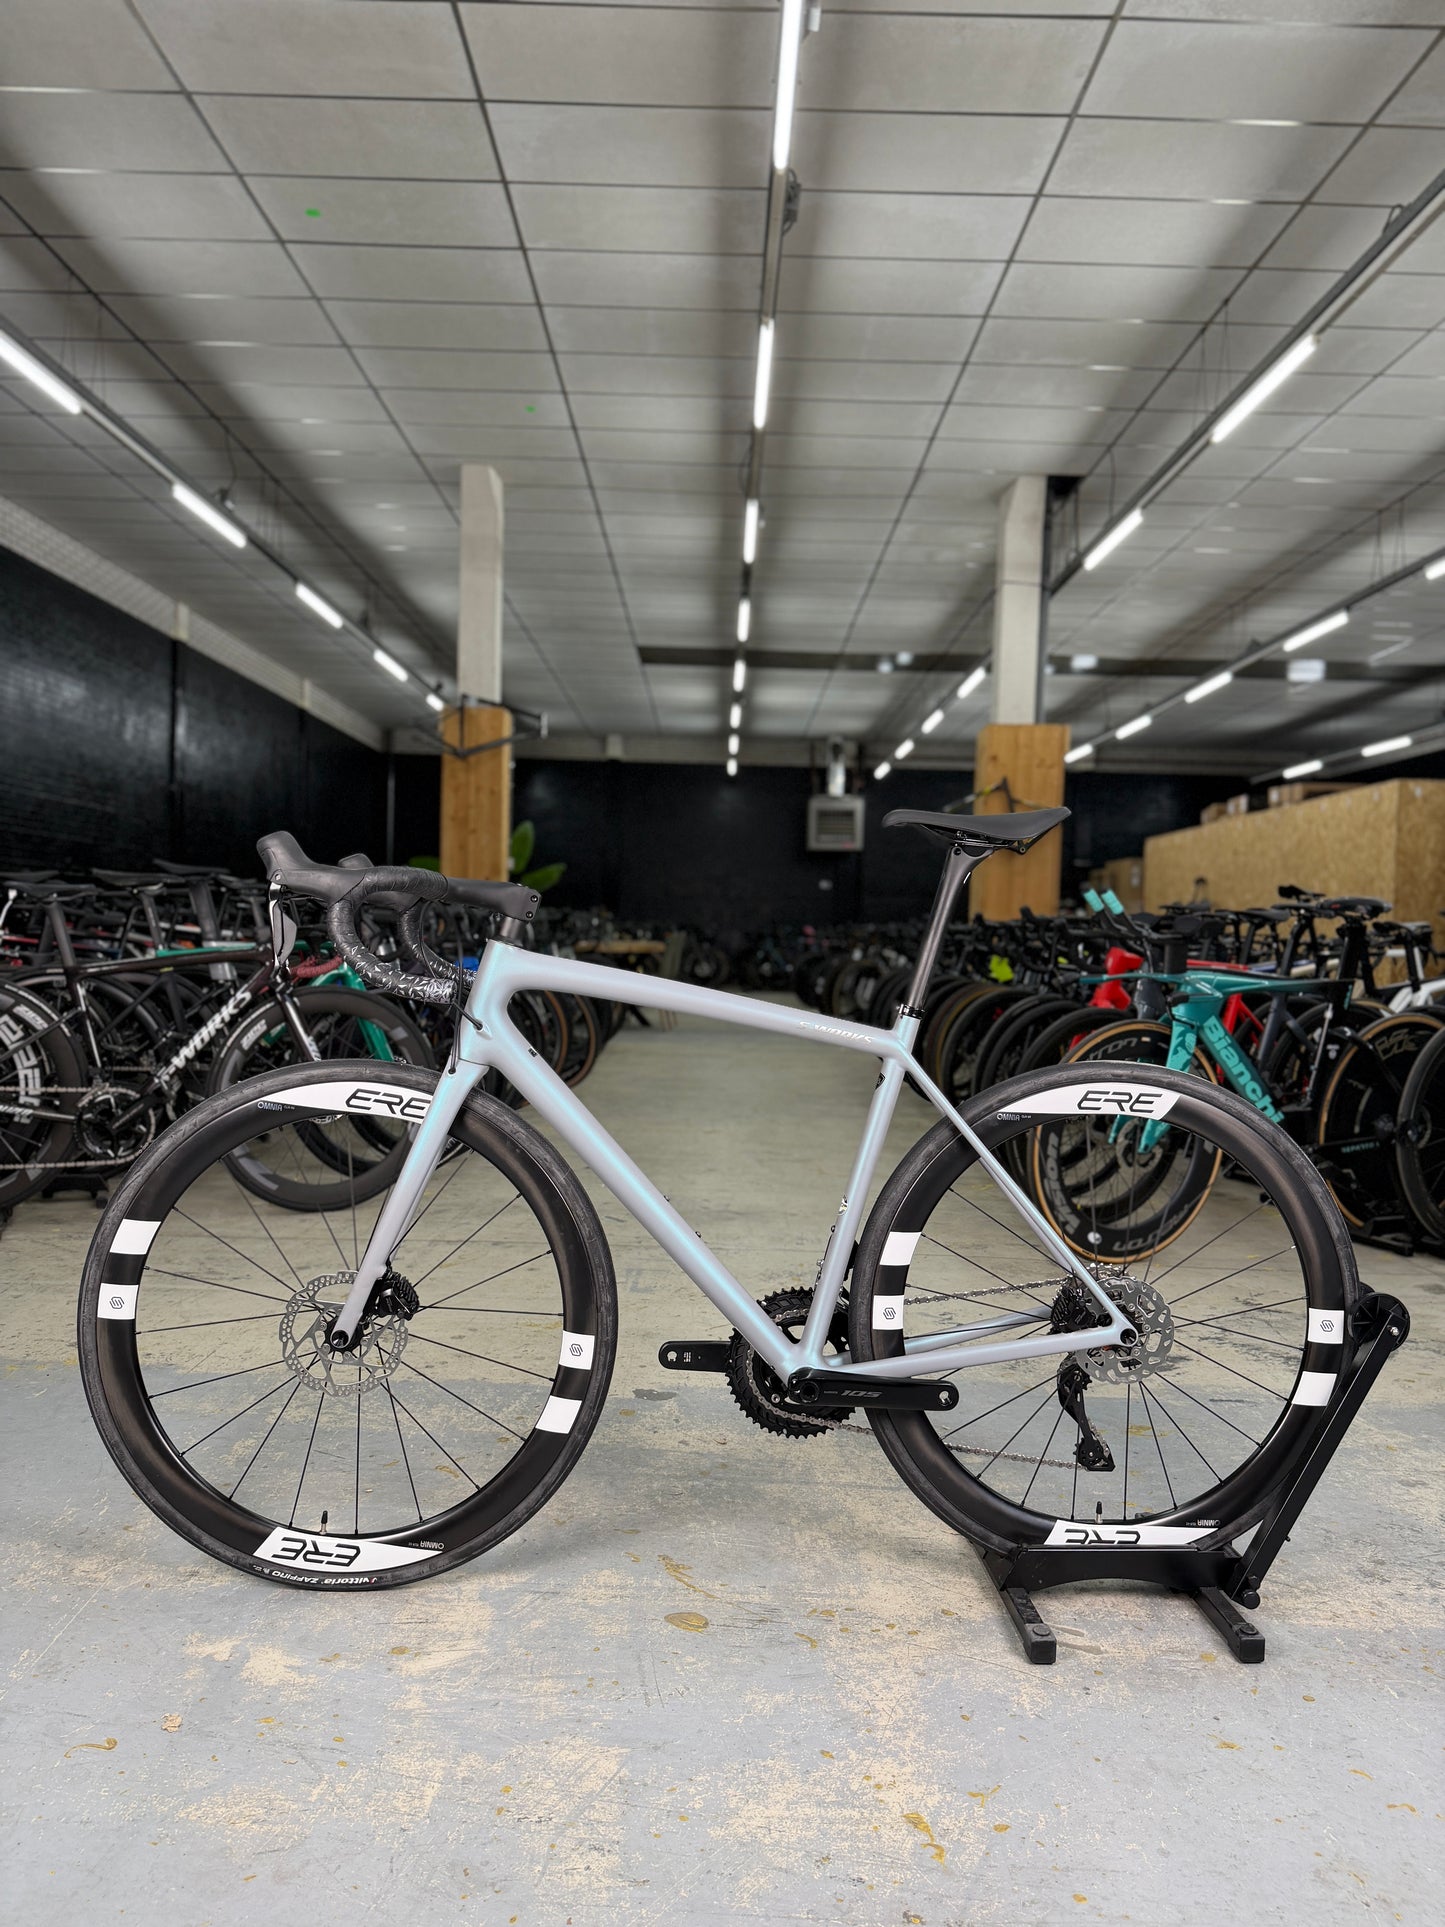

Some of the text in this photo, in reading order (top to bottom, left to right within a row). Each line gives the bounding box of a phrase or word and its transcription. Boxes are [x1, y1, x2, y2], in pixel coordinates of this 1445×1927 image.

[1203, 1015, 1285, 1123] Bianchi
[257, 1101, 283, 1112] OMNIA
[345, 1087, 431, 1119] ERE
[1077, 1089, 1163, 1113] ERE
[996, 1113, 1021, 1122] OMNIA
[840, 1389, 883, 1398] 105
[1197, 1519, 1221, 1527] OMNIA
[271, 1536, 361, 1567] ERE
[420, 1540, 445, 1550] OMNIA
[271, 1569, 320, 1584] ZAFFIRO
